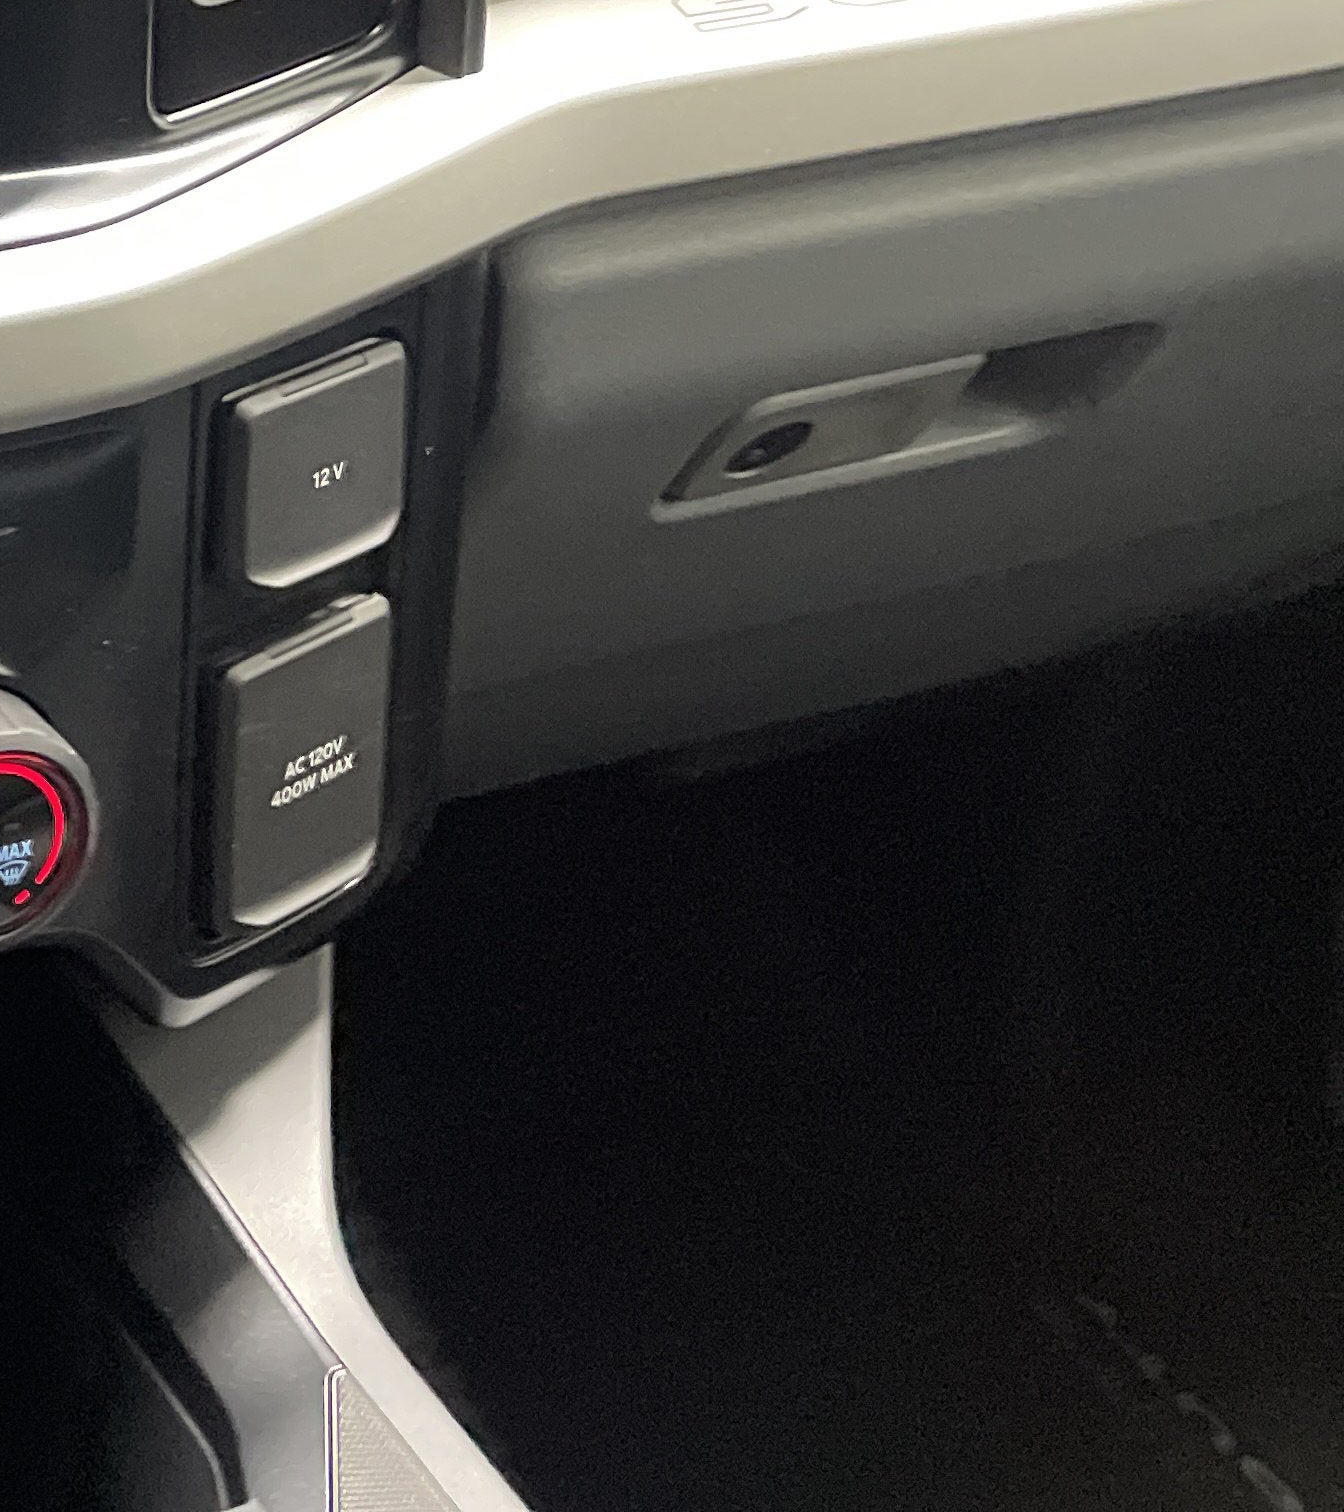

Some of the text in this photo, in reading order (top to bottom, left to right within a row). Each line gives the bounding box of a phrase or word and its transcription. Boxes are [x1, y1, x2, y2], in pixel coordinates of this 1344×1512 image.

[270, 752, 356, 807] 400W MAX
[284, 735, 346, 781] AC 120V
